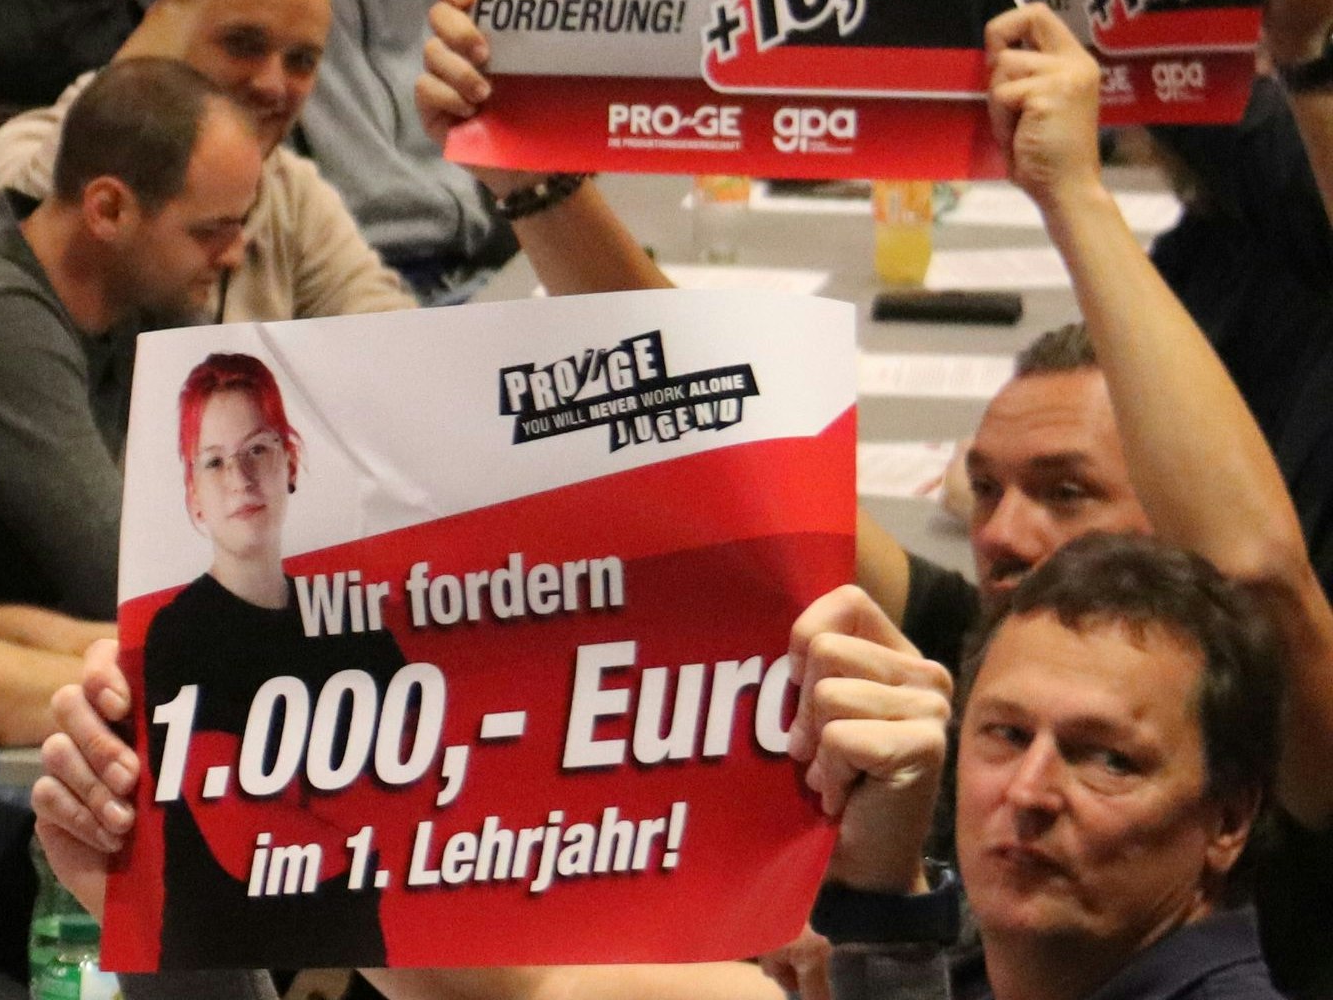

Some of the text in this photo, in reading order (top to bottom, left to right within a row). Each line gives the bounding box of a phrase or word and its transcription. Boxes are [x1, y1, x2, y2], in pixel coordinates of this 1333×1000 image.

[608, 103, 857, 154] PRO-GE gpa
[521, 374, 746, 437] YOU WILL NEVER WORK ALONE
[615, 397, 740, 445] JUGEND
[293, 555, 625, 638] Wir fordern
[150, 640, 801, 805] 1.000,- Euro
[247, 802, 686, 897] im 1. Lehrjahr!
